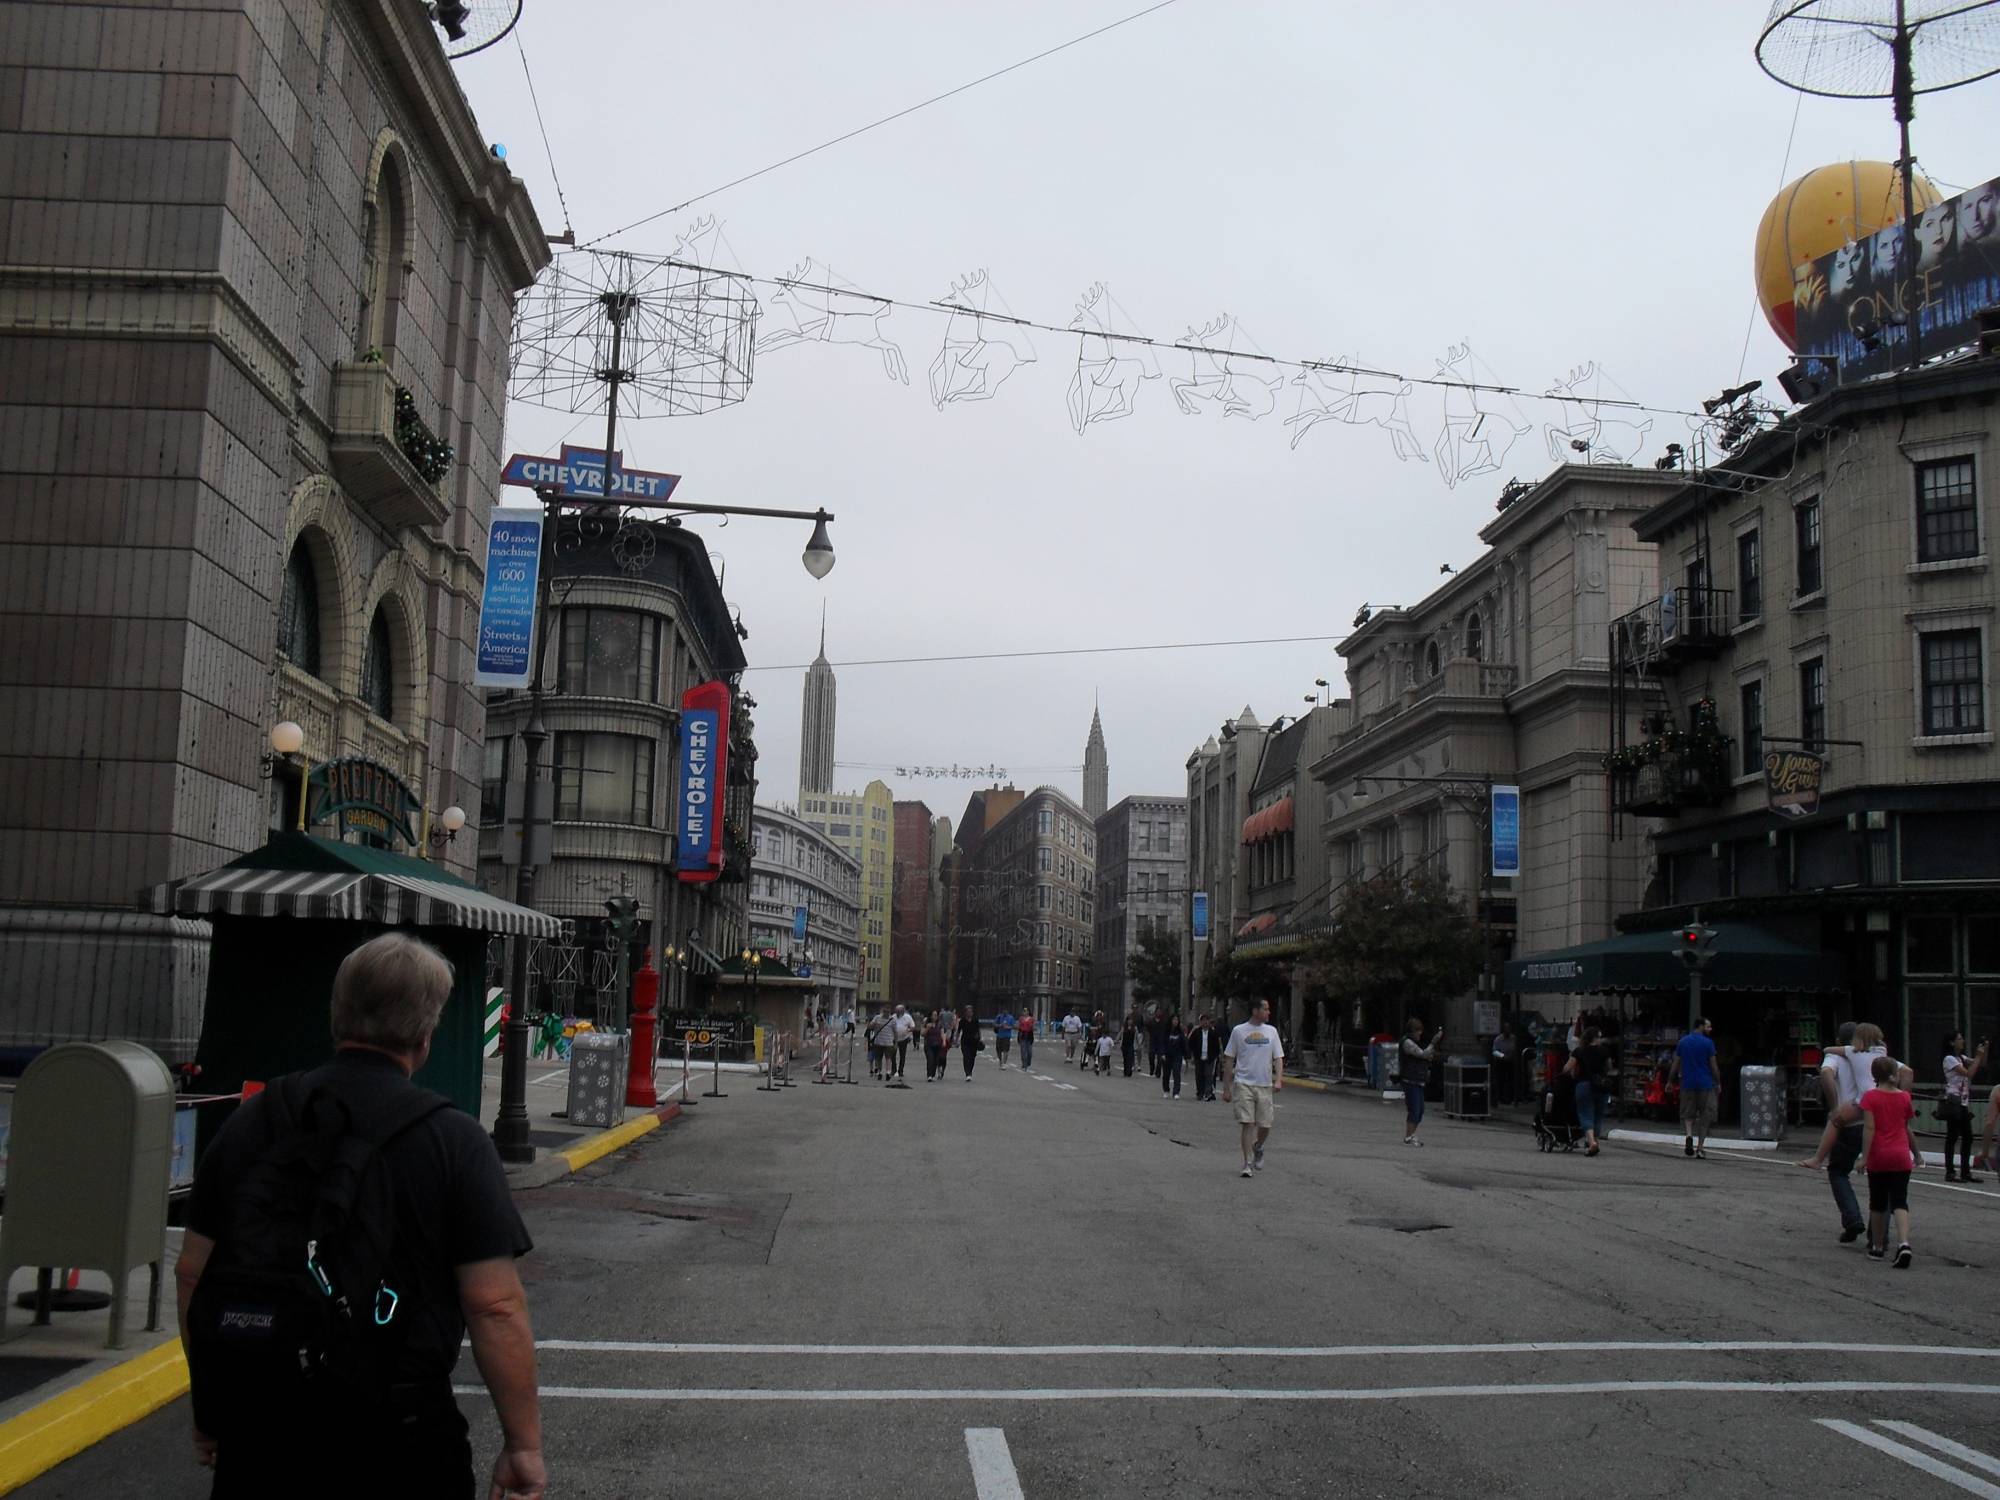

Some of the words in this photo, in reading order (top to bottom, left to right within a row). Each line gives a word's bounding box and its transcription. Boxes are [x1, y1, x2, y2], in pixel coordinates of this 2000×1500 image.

[522, 461, 660, 496] CHEVROLET
[493, 530, 509, 543] 40
[510, 535, 537, 543] snow
[490, 545, 537, 557] machines
[484, 627, 521, 641] Streets
[1766, 753, 1821, 788] Youse
[686, 720, 709, 846] CHEVROLET
